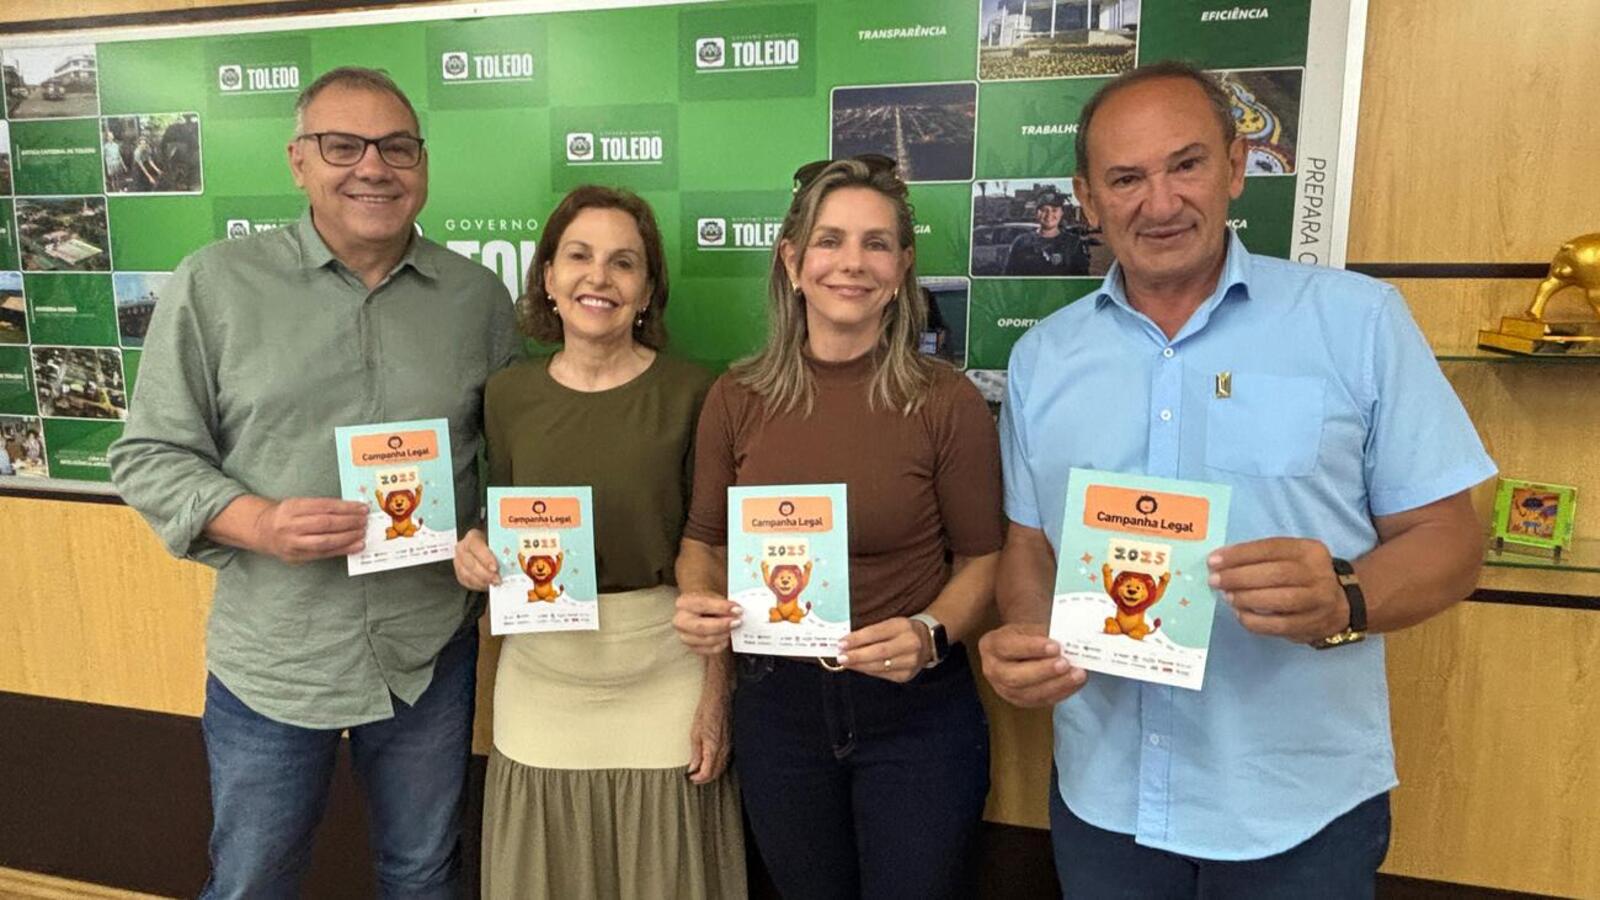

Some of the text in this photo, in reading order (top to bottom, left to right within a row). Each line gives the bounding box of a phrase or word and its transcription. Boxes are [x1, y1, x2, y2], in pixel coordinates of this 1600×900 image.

[1201, 7, 1269, 21] EFICIÊNCIA
[858, 24, 947, 40] TRANSPARÊNCIA
[731, 39, 799, 67] TOLEDO
[473, 53, 533, 79] TOLEDO
[247, 66, 299, 90] TOLEDO
[600, 136, 663, 161] TOLEDO
[1299, 157, 1327, 245] PREPARA
[445, 219, 538, 231] GOVERNO
[362, 450, 406, 462] Campanha
[407, 448, 430, 458] Legal
[380, 471, 416, 485] 2025
[508, 515, 571, 524] Campanha Legal
[752, 517, 823, 529] Campanha Legal
[1097, 511, 1158, 528] Campanha
[1160, 519, 1194, 533] Legal
[523, 539, 557, 549] 2025
[768, 545, 806, 557] 2025
[1114, 546, 1166, 565] 2025
